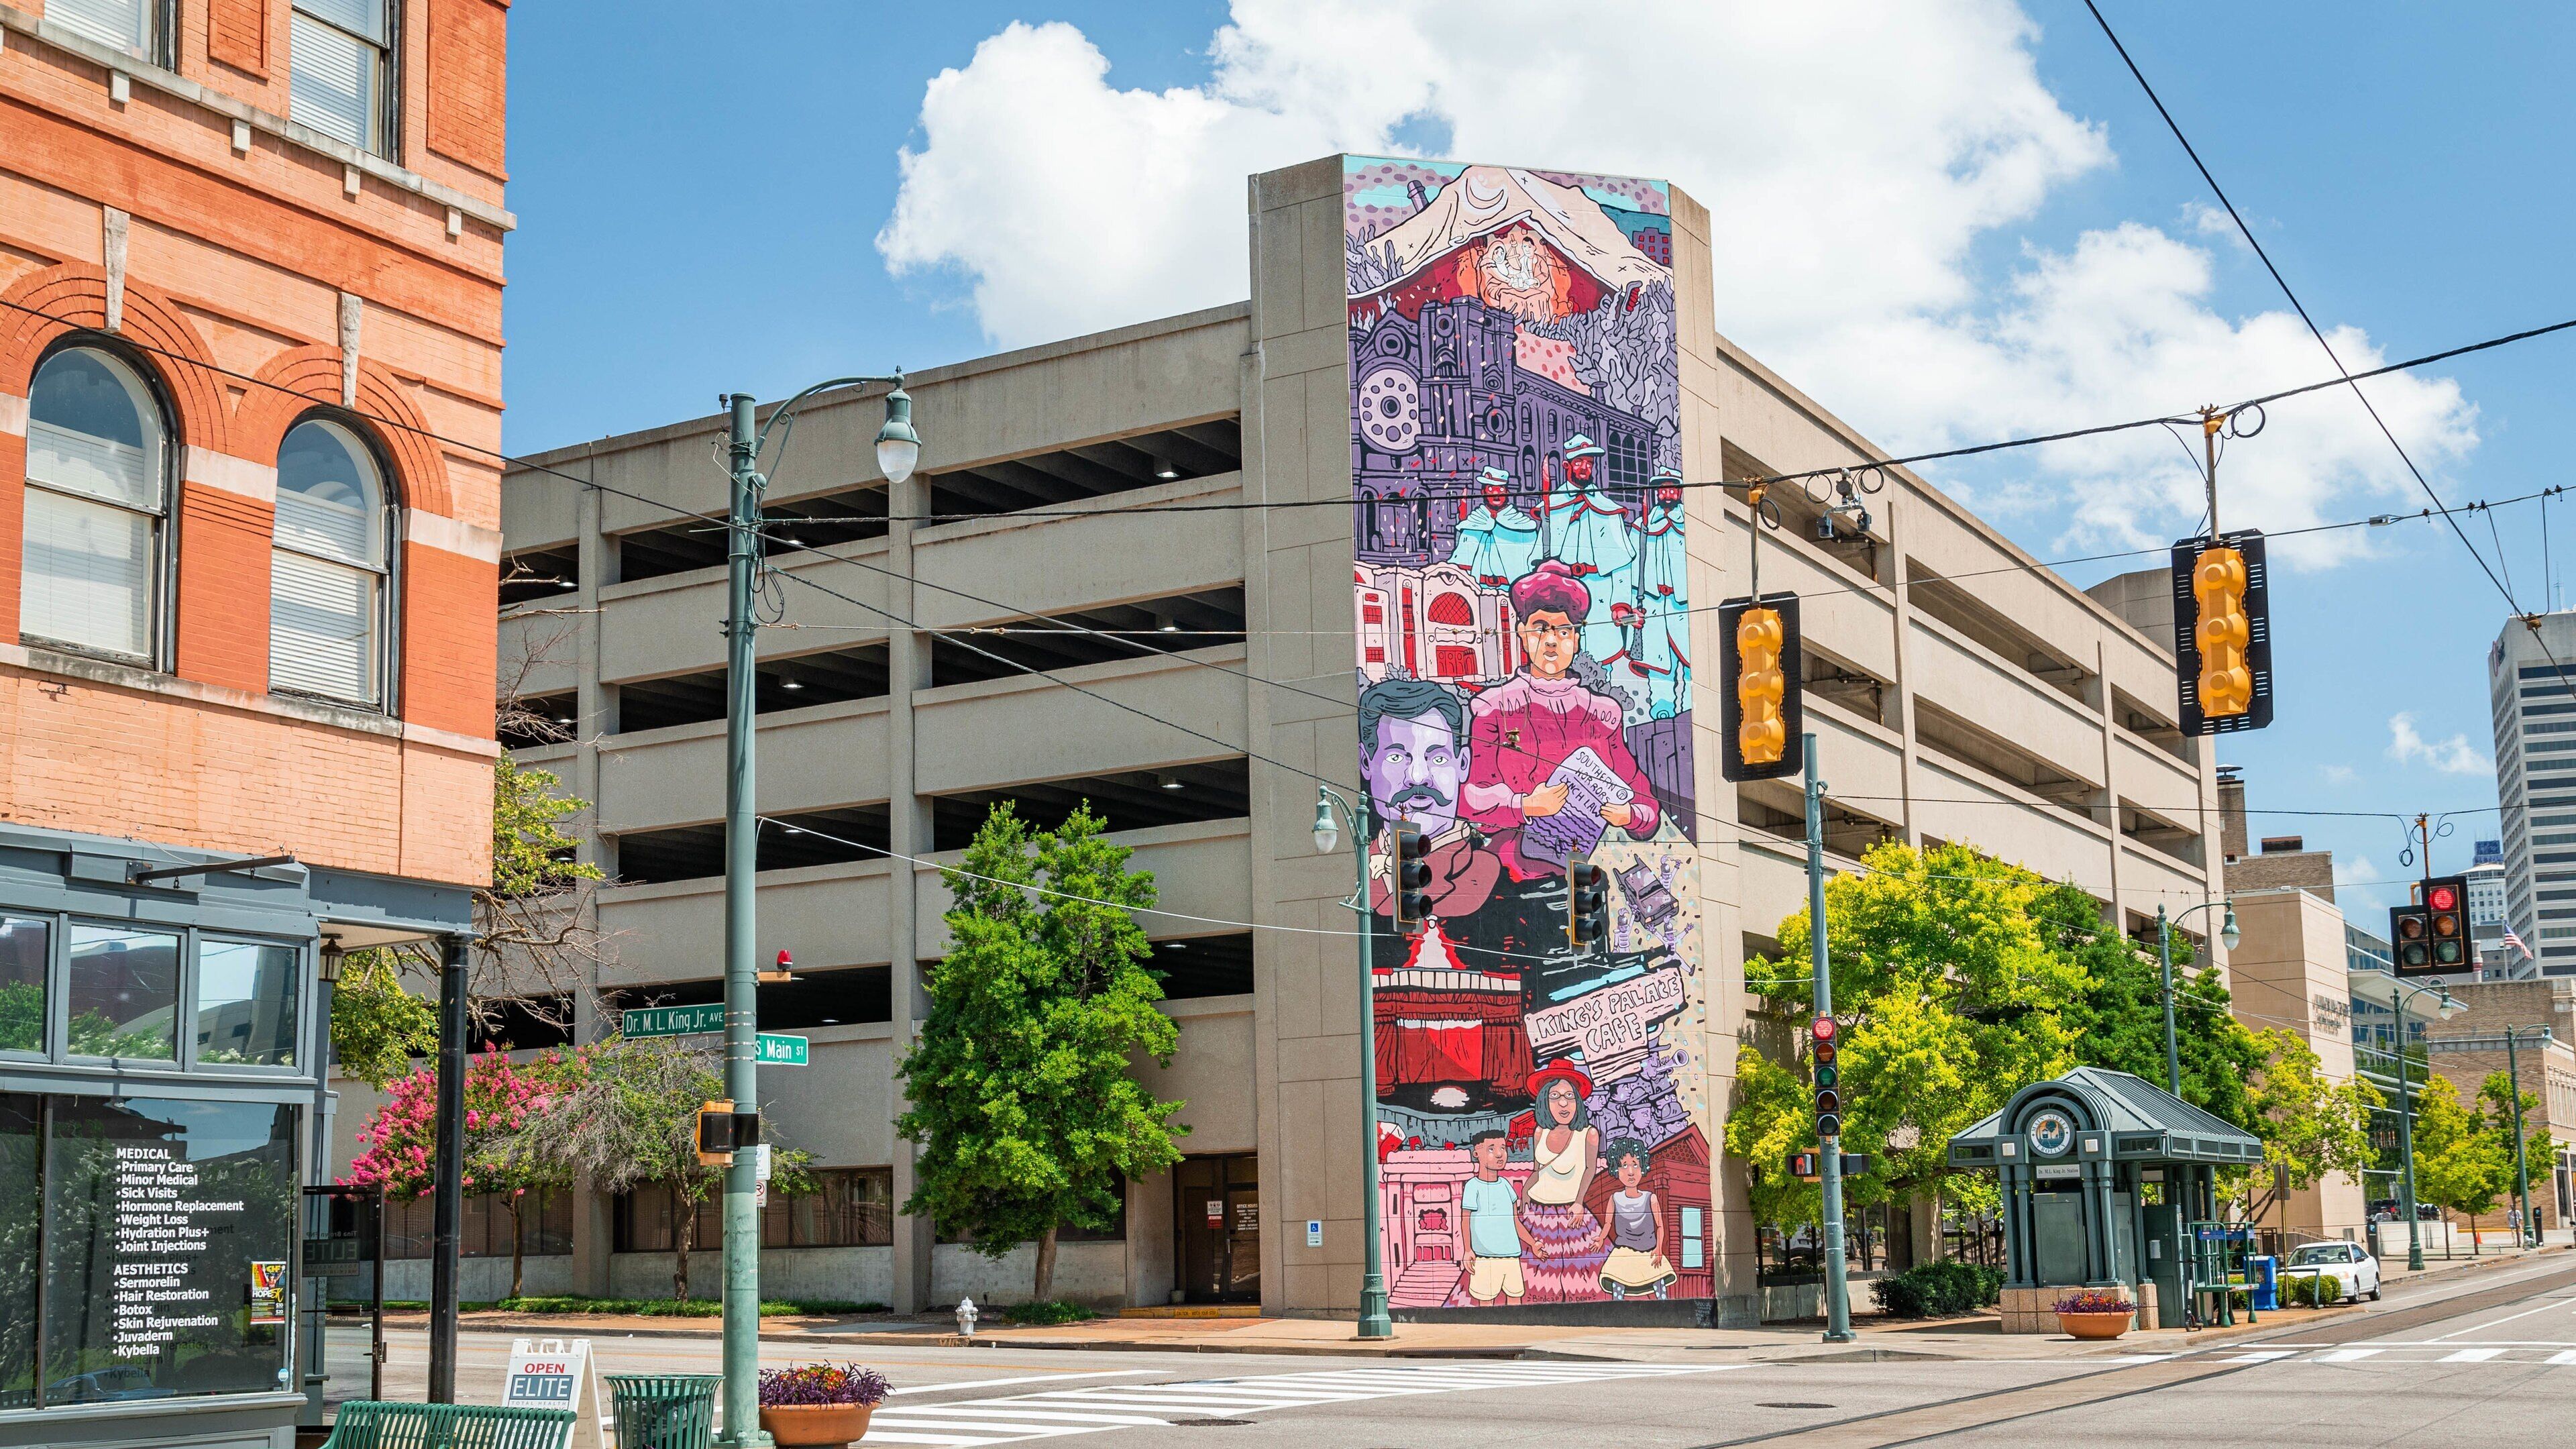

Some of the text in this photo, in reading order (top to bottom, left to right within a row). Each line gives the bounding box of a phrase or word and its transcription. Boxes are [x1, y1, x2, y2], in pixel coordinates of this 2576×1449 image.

[1576, 751, 1617, 792] SOUTHERN
[1575, 767, 1611, 804] HORRORS
[1560, 774, 1601, 818] LYNCH LAW
[1536, 977, 1680, 1038] KING'S PALACE
[626, 1010, 723, 1033] Dr. M. L. King Jr. AVE
[1586, 1012, 1642, 1053] CAFE
[755, 1039, 804, 1059] S Main ST
[2032, 1115, 2068, 1131] MAIN STREET
[116, 1148, 171, 1160] MEDICAL
[2037, 1143, 2066, 1154] TROLLEY
[121, 1161, 193, 1174] Primary Care
[122, 1174, 198, 1185] Minor Medical
[121, 1187, 178, 1198] Sick Visits
[121, 1200, 244, 1214] Hormone Replacement
[121, 1214, 188, 1227] Weight Loss
[121, 1227, 209, 1240] Hydration Plus+
[120, 1240, 207, 1253] Joint Injections
[113, 1263, 189, 1275] AESTHETICS
[119, 1276, 180, 1288] Sermorelin
[119, 1289, 209, 1302] Hair Restoration
[252, 1290, 272, 1298] HOPE
[119, 1304, 153, 1316] Botox
[118, 1315, 218, 1330] Skin Rejuvenation
[117, 1330, 173, 1342] Juvaderm
[117, 1344, 160, 1358] Kybella
[525, 1363, 565, 1374] OPEN
[513, 1377, 570, 1397] ELITE
